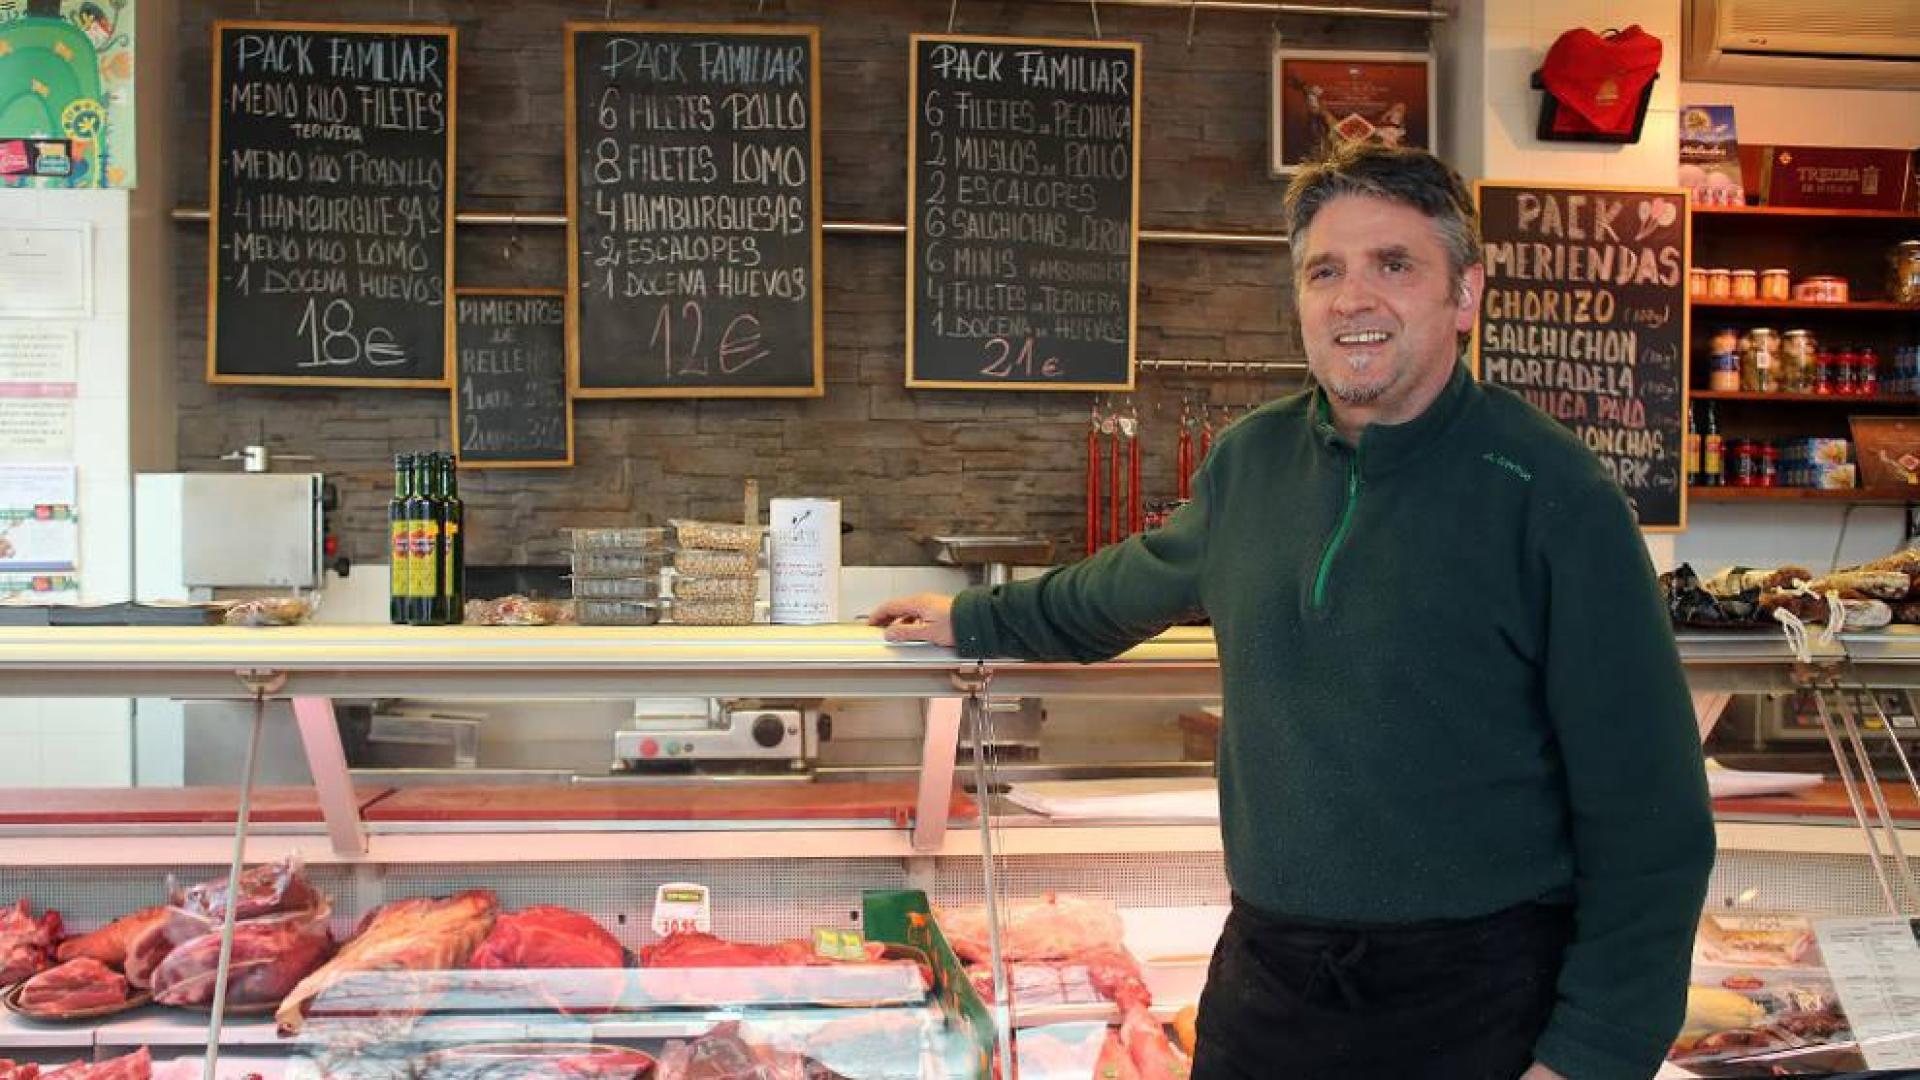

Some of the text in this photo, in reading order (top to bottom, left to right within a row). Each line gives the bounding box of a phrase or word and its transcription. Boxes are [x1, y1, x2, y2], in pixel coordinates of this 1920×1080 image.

[238, 35, 443, 88] PACK FAMILIAR
[601, 38, 804, 87] PACK FAMILIAR
[929, 43, 1129, 96] PACK FAMILIAR
[306, 84, 347, 123] KILO
[355, 85, 444, 135] FILETES
[628, 93, 716, 132] FILETES
[720, 91, 806, 131] POLLO
[924, 89, 944, 128] 6
[952, 91, 1036, 135] FILETES
[308, 154, 341, 183] KILO
[628, 142, 718, 185] FILETES
[731, 141, 806, 187] LOMO
[923, 131, 948, 166] 2
[955, 135, 1040, 177] MUSLOS
[1064, 141, 1129, 181] POLLO
[926, 170, 1098, 213] 2 ESCALOPES
[260, 193, 441, 240] HAMBURGUESAS
[622, 191, 804, 237] HAMBURGUESAS
[924, 206, 946, 238] 6
[950, 207, 1068, 249] SALCHICHAS
[1516, 192, 1623, 243] PACK
[308, 239, 346, 263] KILO
[356, 239, 430, 272] LOMO
[626, 235, 761, 267] ESCALOPES
[925, 241, 946, 273] 6
[952, 246, 1019, 278] MINIS
[1483, 242, 1681, 288] MERIENDAS
[262, 266, 348, 294] DOCENA
[359, 271, 443, 305] HUEVOS
[623, 268, 707, 298] DOCENA
[712, 266, 807, 302] HUEVOS
[927, 277, 944, 311] 4
[946, 280, 1026, 312] FILETES
[1038, 285, 1122, 314] TERNERA
[458, 299, 563, 326] PIMIENTOS
[931, 310, 943, 337] 1
[946, 314, 1032, 339] DOCENA
[1486, 288, 1615, 324] CHORIZO
[1484, 322, 1637, 365] SALCHICHON
[1486, 355, 1634, 397] MORTADELA
